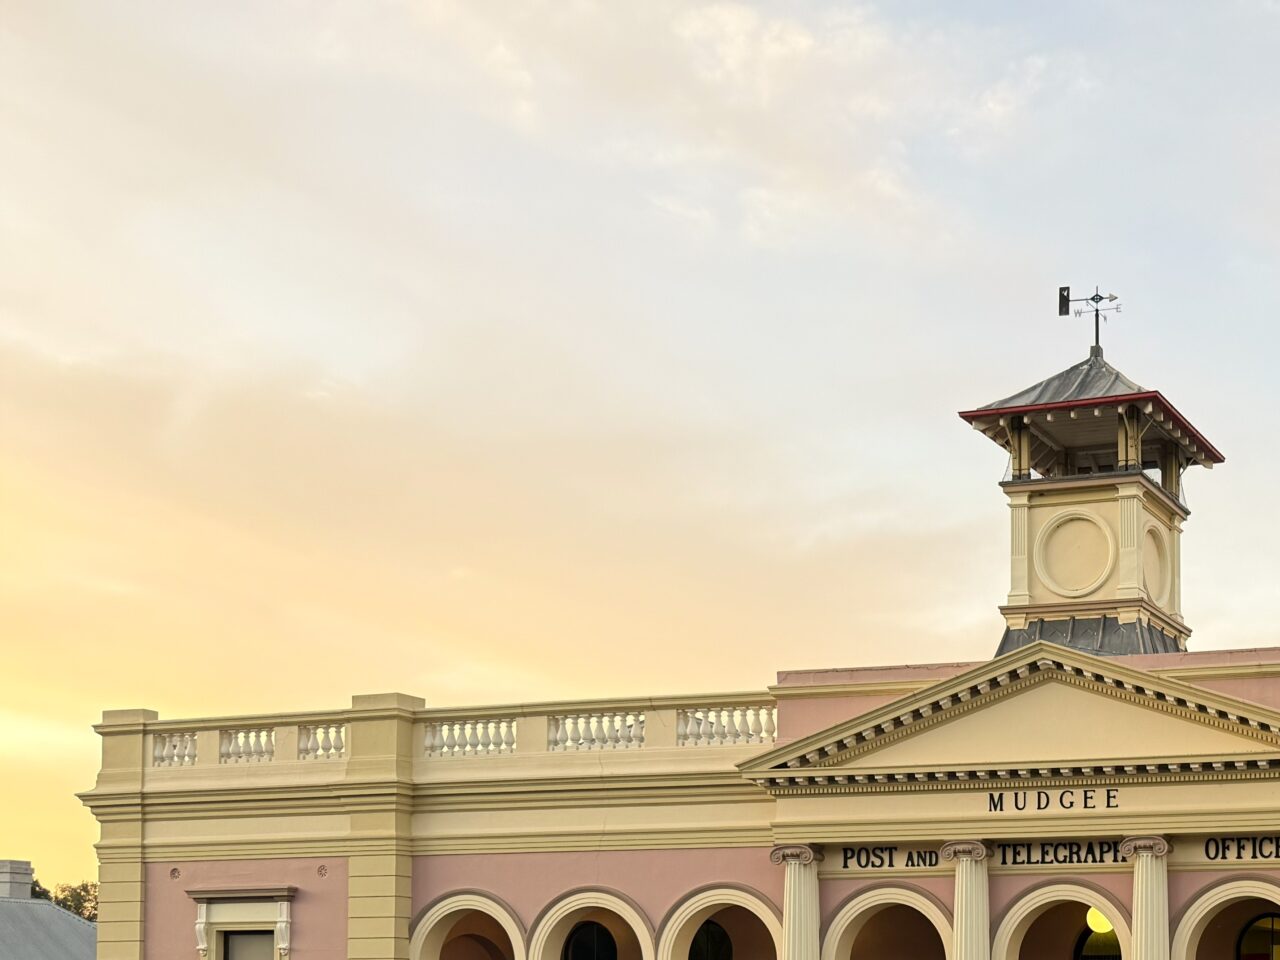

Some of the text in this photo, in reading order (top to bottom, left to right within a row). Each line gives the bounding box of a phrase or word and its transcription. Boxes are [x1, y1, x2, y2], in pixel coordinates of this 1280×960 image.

[988, 789, 1119, 812] MUDGEE
[842, 846, 898, 869] POST
[905, 850, 939, 867] AND
[997, 840, 1128, 866] TELEGRAPH
